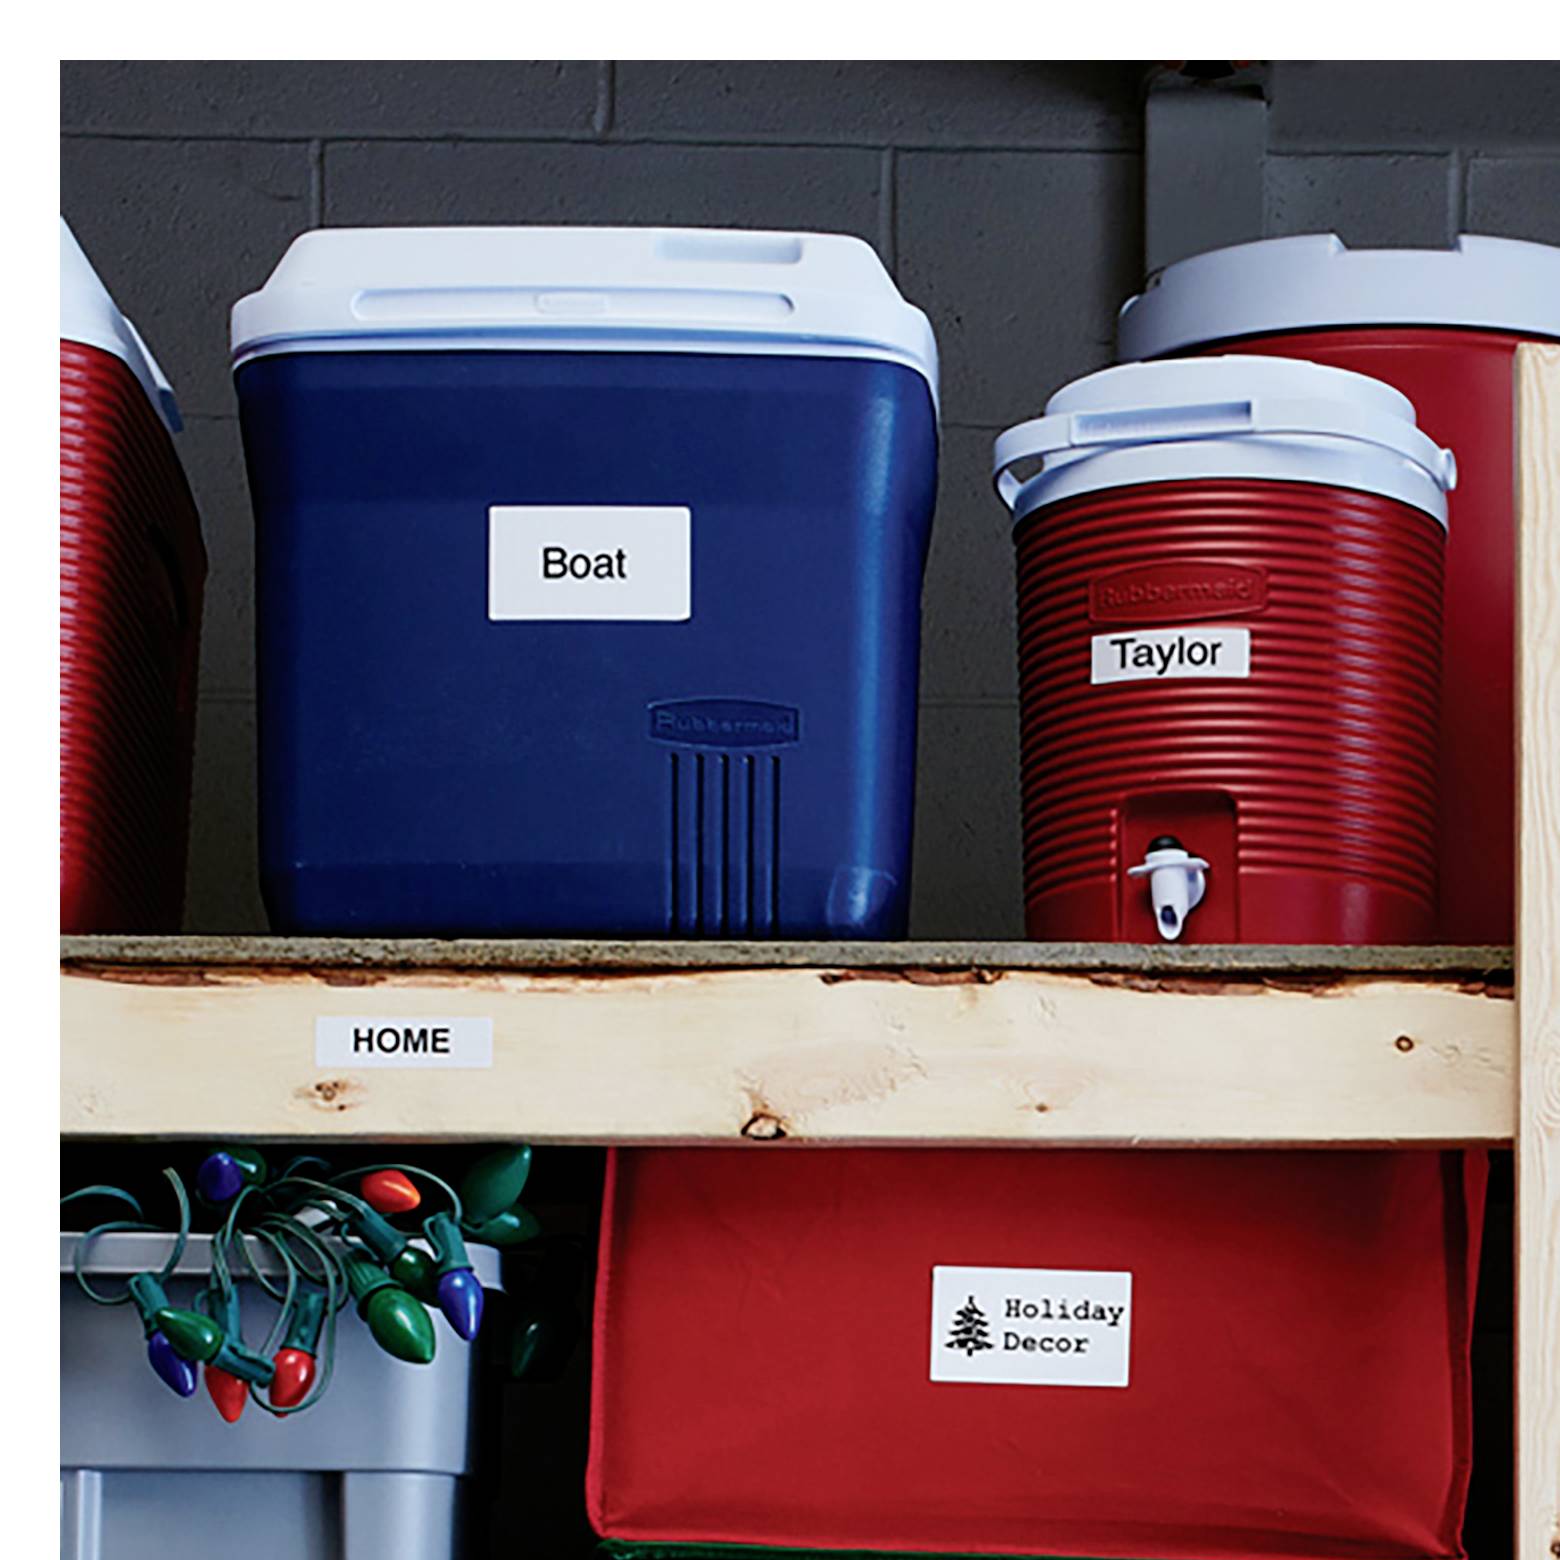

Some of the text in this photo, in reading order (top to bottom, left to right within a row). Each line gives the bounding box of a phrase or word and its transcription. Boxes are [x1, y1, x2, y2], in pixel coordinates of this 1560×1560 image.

[542, 546, 628, 580] Boat
[1109, 635, 1222, 676] Taylor
[353, 1027, 450, 1054] HOME
[1004, 1298, 1125, 1327] Holiday
[1003, 1331, 1089, 1354] Decor
